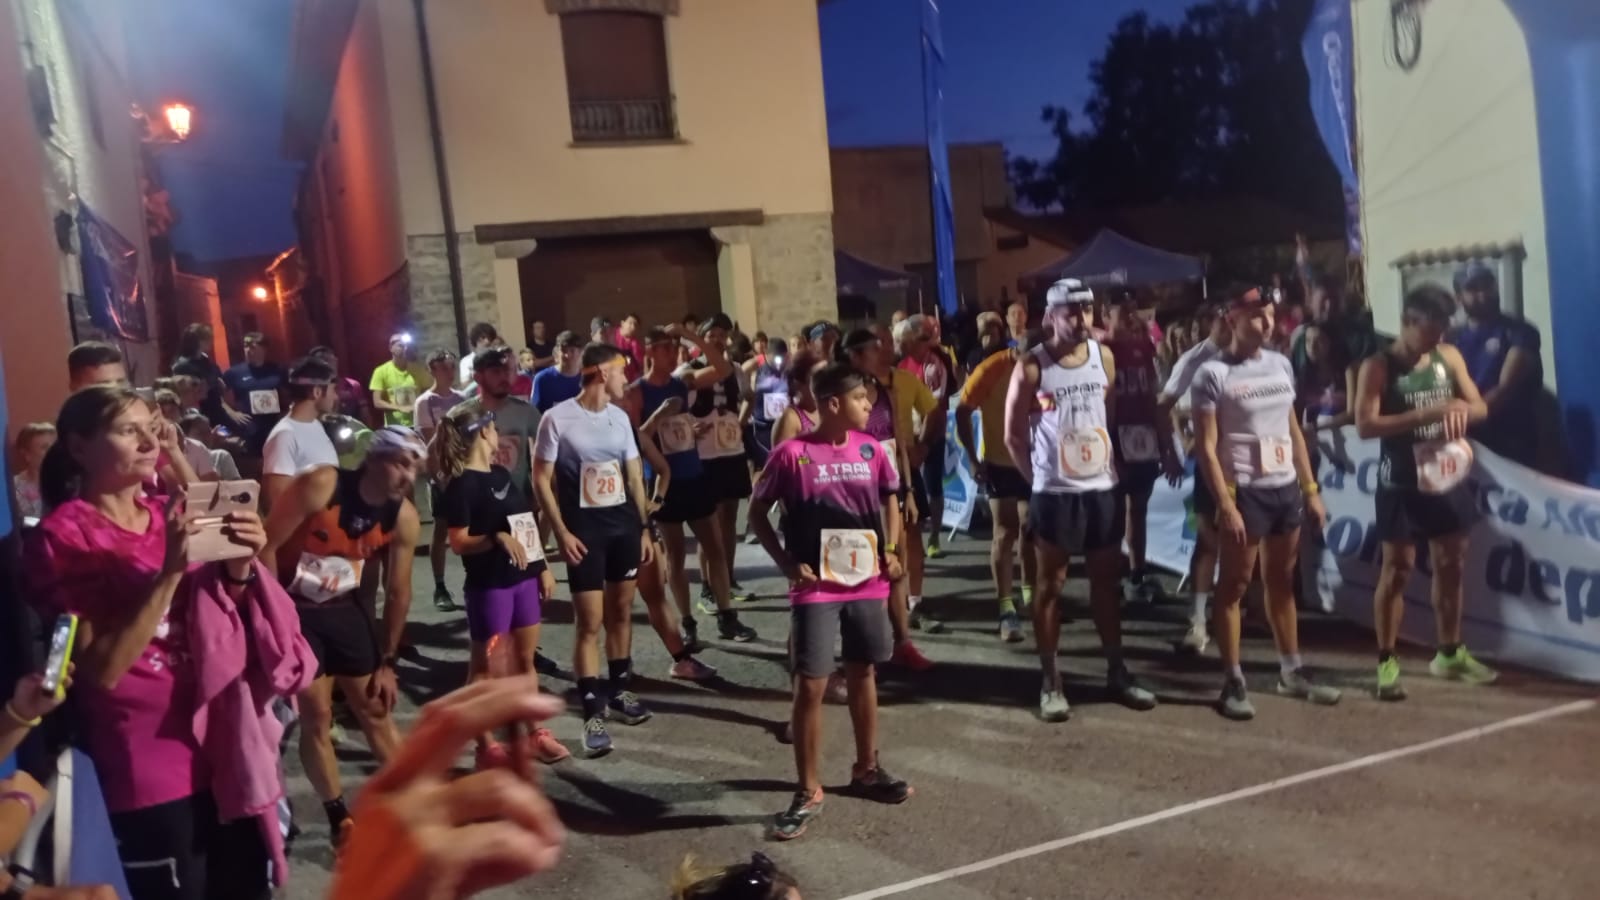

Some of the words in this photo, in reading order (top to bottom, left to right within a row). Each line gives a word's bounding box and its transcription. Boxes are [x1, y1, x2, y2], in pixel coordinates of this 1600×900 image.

[1081, 444, 1092, 463] 5
[1275, 446, 1285, 464] 9
[817, 463, 829, 478] X
[596, 476, 616, 495] 28
[525, 528, 536, 549] 27
[848, 549, 857, 569] 1
